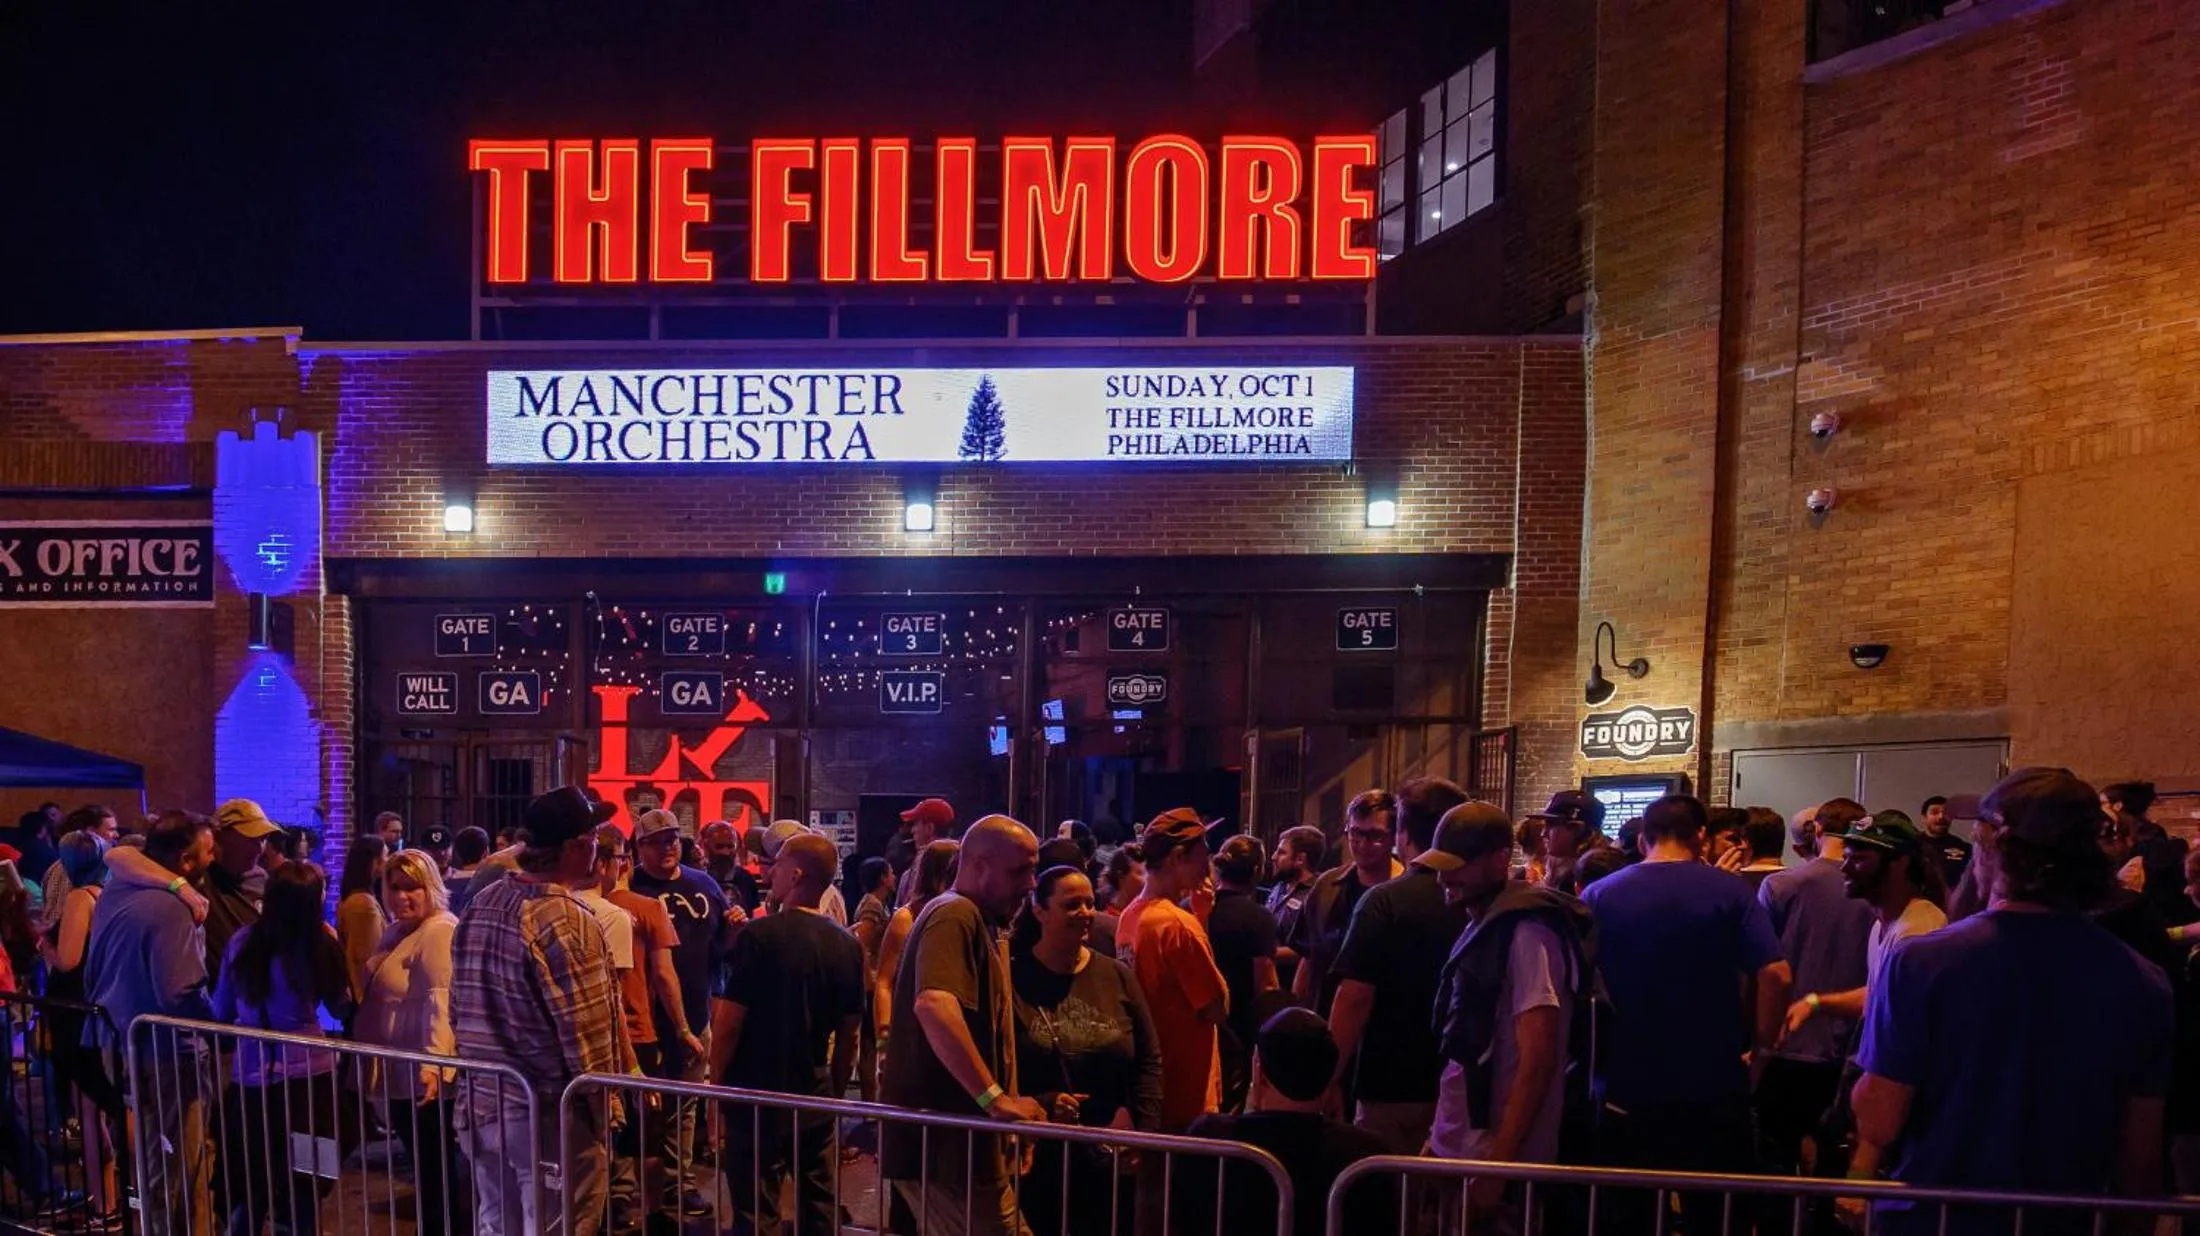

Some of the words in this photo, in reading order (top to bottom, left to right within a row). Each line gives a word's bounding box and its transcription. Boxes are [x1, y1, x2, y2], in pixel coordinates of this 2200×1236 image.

[469, 139, 713, 282] THE
[751, 135, 1377, 282] FILLMORE
[1106, 375, 1233, 399] SUNDAY,
[1239, 375, 1300, 397] OCT
[514, 374, 904, 417] MANCHESTER
[1106, 408, 1161, 429] THE
[1170, 407, 1314, 429] FILLMORE
[541, 420, 876, 461] ORCHESTRA
[1107, 433, 1312, 456] PHILADELPHIA
[36, 539, 201, 576] OFFICE
[16, 582, 51, 593] AND
[64, 580, 198, 592] INFORMATION
[441, 618, 490, 634] GATE
[669, 617, 717, 633] GATE
[887, 616, 936, 633] GATE
[1114, 613, 1162, 629] GATE
[1343, 612, 1392, 628] GATE
[461, 637, 469, 652] 1
[688, 635, 699, 651] 2
[906, 634, 917, 650] 3
[1131, 631, 1144, 646] 4
[1361, 629, 1373, 645] 5
[406, 677, 449, 693] WILL
[489, 681, 530, 705] GA
[671, 681, 713, 705] GA
[886, 682, 937, 702] V.I.P.
[404, 694, 450, 709] CALL
[1583, 721, 1691, 745] FOUNDRY
